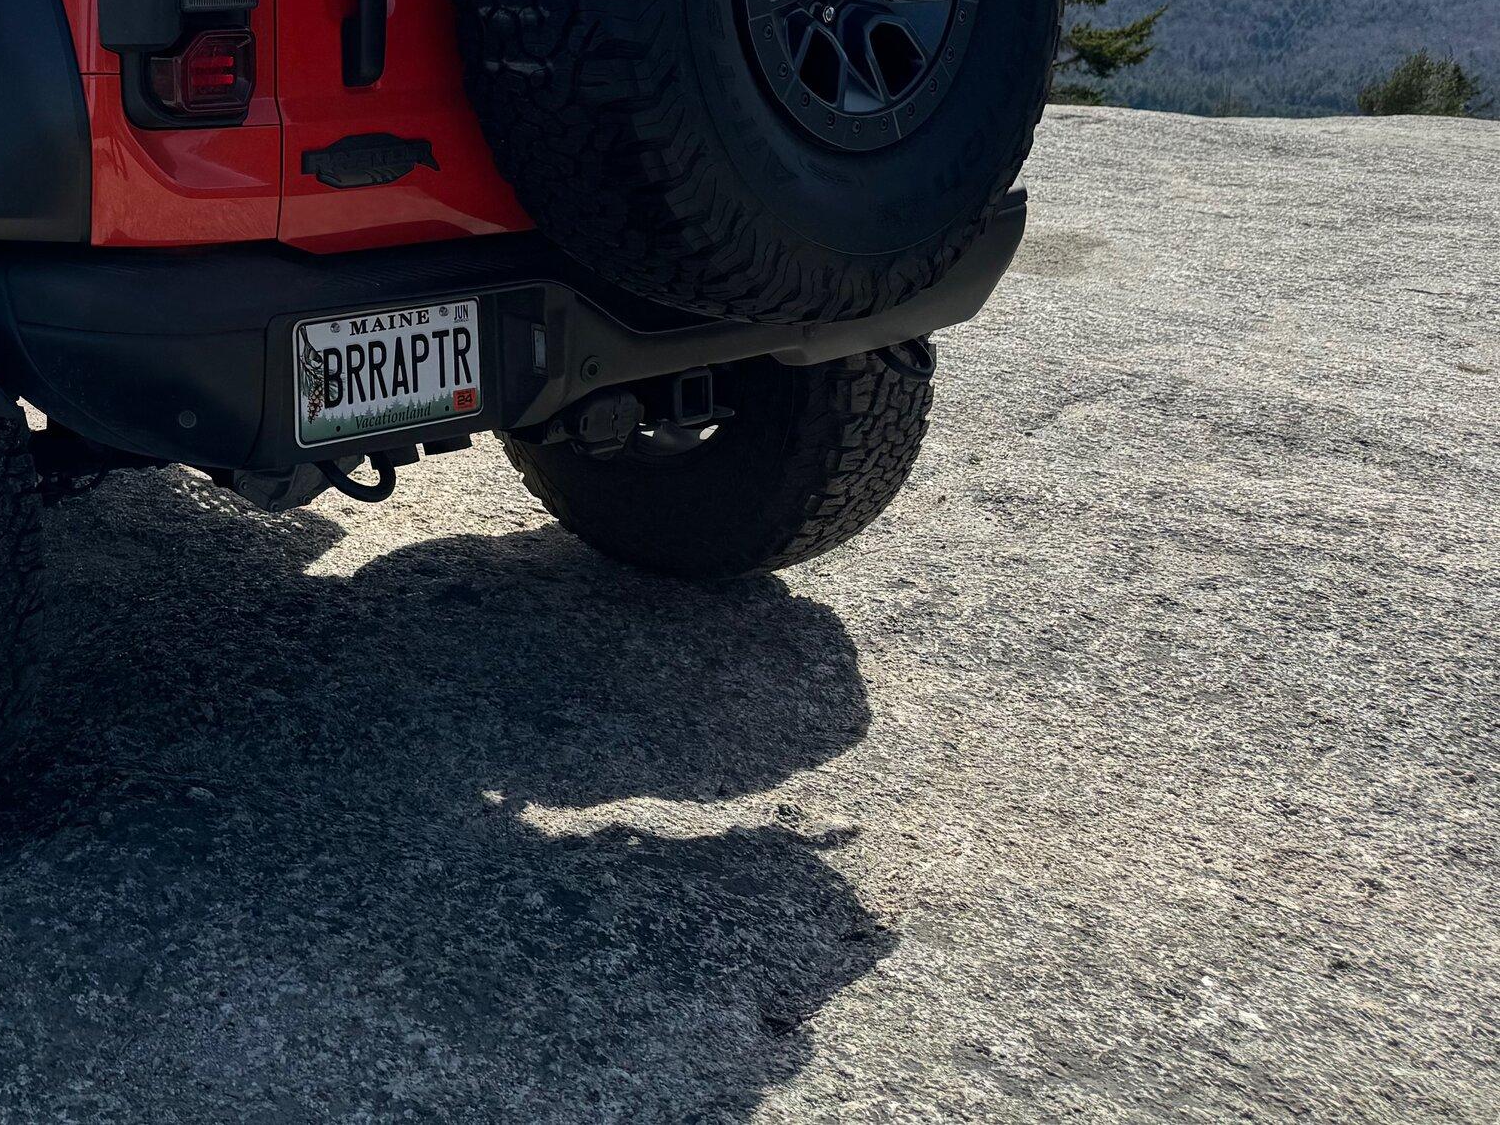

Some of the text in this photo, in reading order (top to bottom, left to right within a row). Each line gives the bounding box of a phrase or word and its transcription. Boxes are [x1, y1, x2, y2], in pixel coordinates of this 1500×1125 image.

[349, 309, 430, 336] MAINE
[454, 304, 469, 321] JUN
[323, 327, 472, 409] BRRAPTR
[457, 393, 473, 406] 24
[354, 402, 431, 430] Vacationland
